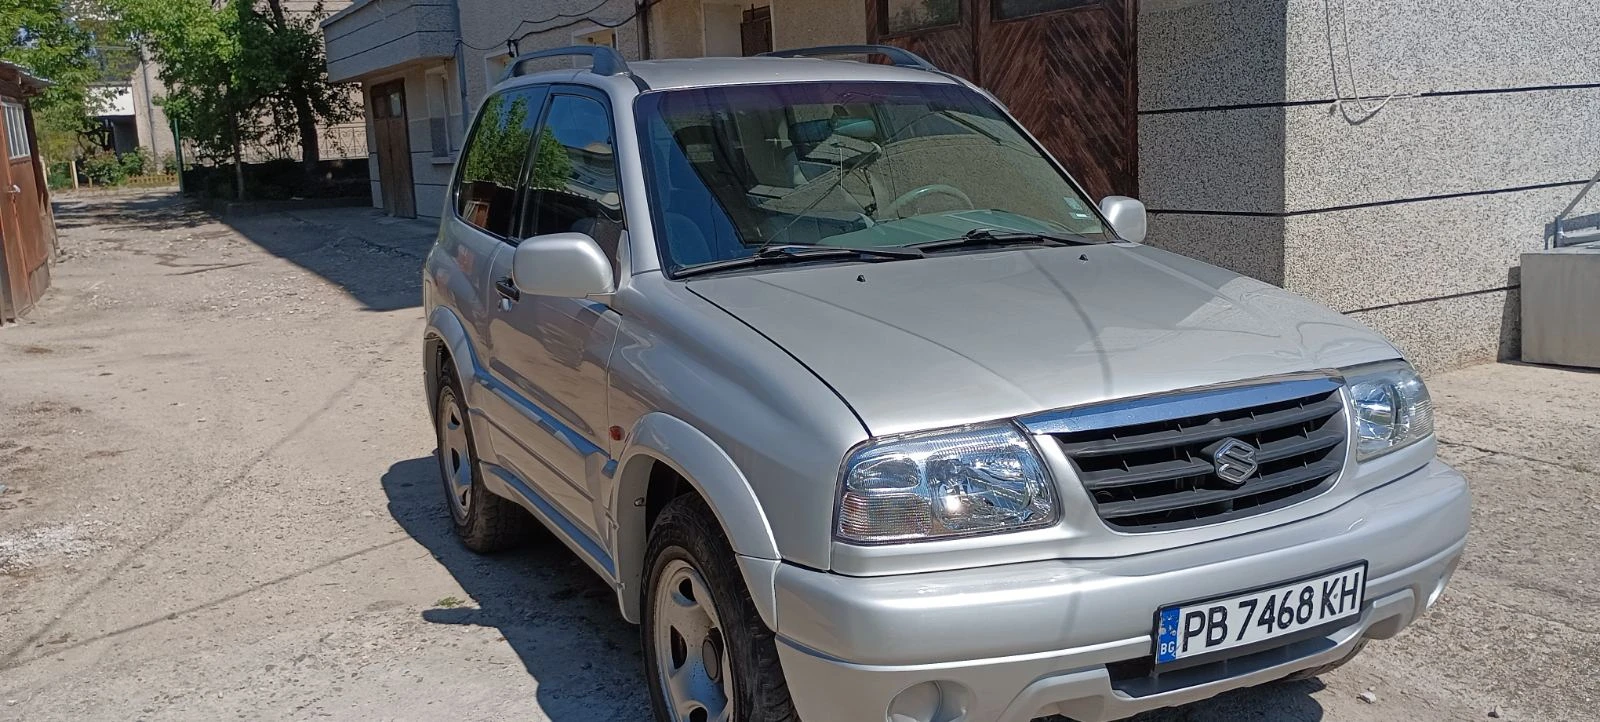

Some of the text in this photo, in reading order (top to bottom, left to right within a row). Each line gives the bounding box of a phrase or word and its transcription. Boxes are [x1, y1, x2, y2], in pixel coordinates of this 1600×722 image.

[1182, 572, 1360, 652] PB 7468 KH
[1160, 640, 1175, 655] BG
